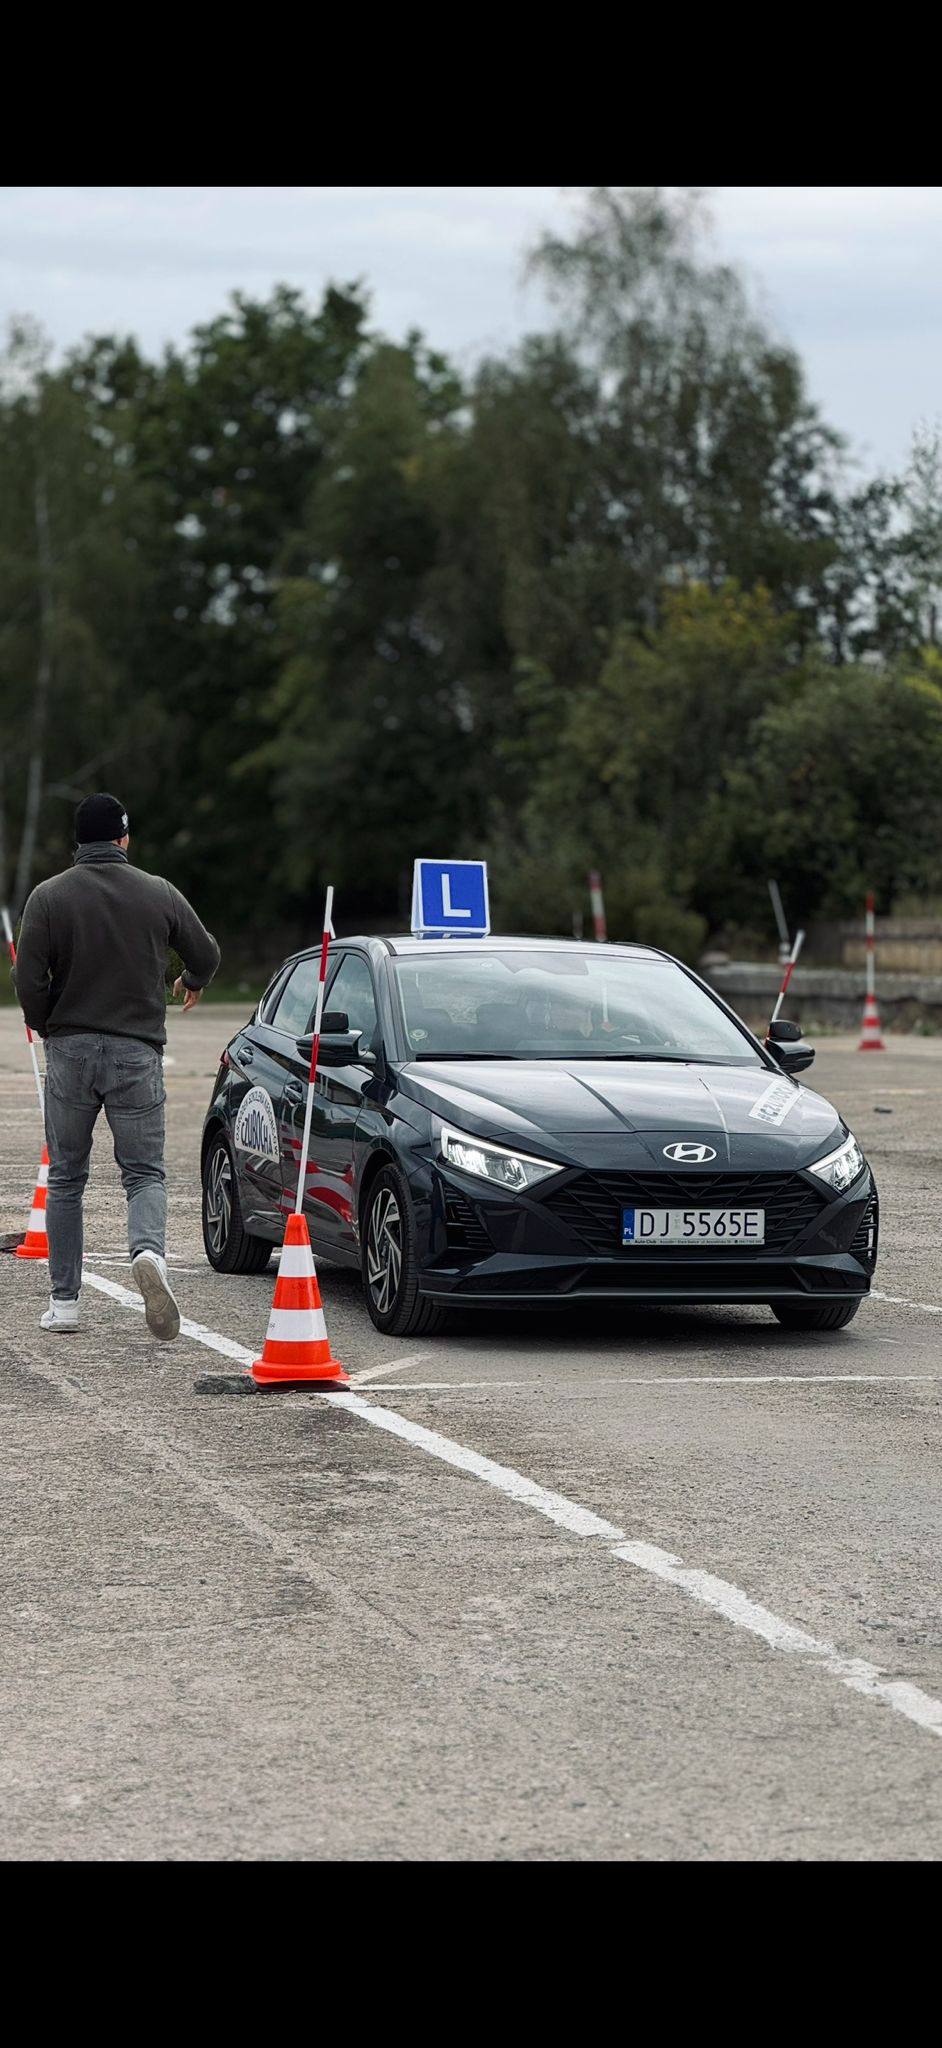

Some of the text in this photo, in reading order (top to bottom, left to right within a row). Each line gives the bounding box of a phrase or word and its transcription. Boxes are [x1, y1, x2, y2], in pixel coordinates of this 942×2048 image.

[441, 873, 472, 917] L
[240, 1109, 273, 1155] CZUBOCHA
[624, 1227, 634, 1235] PL
[639, 1212, 758, 1237] DJ 5565E
